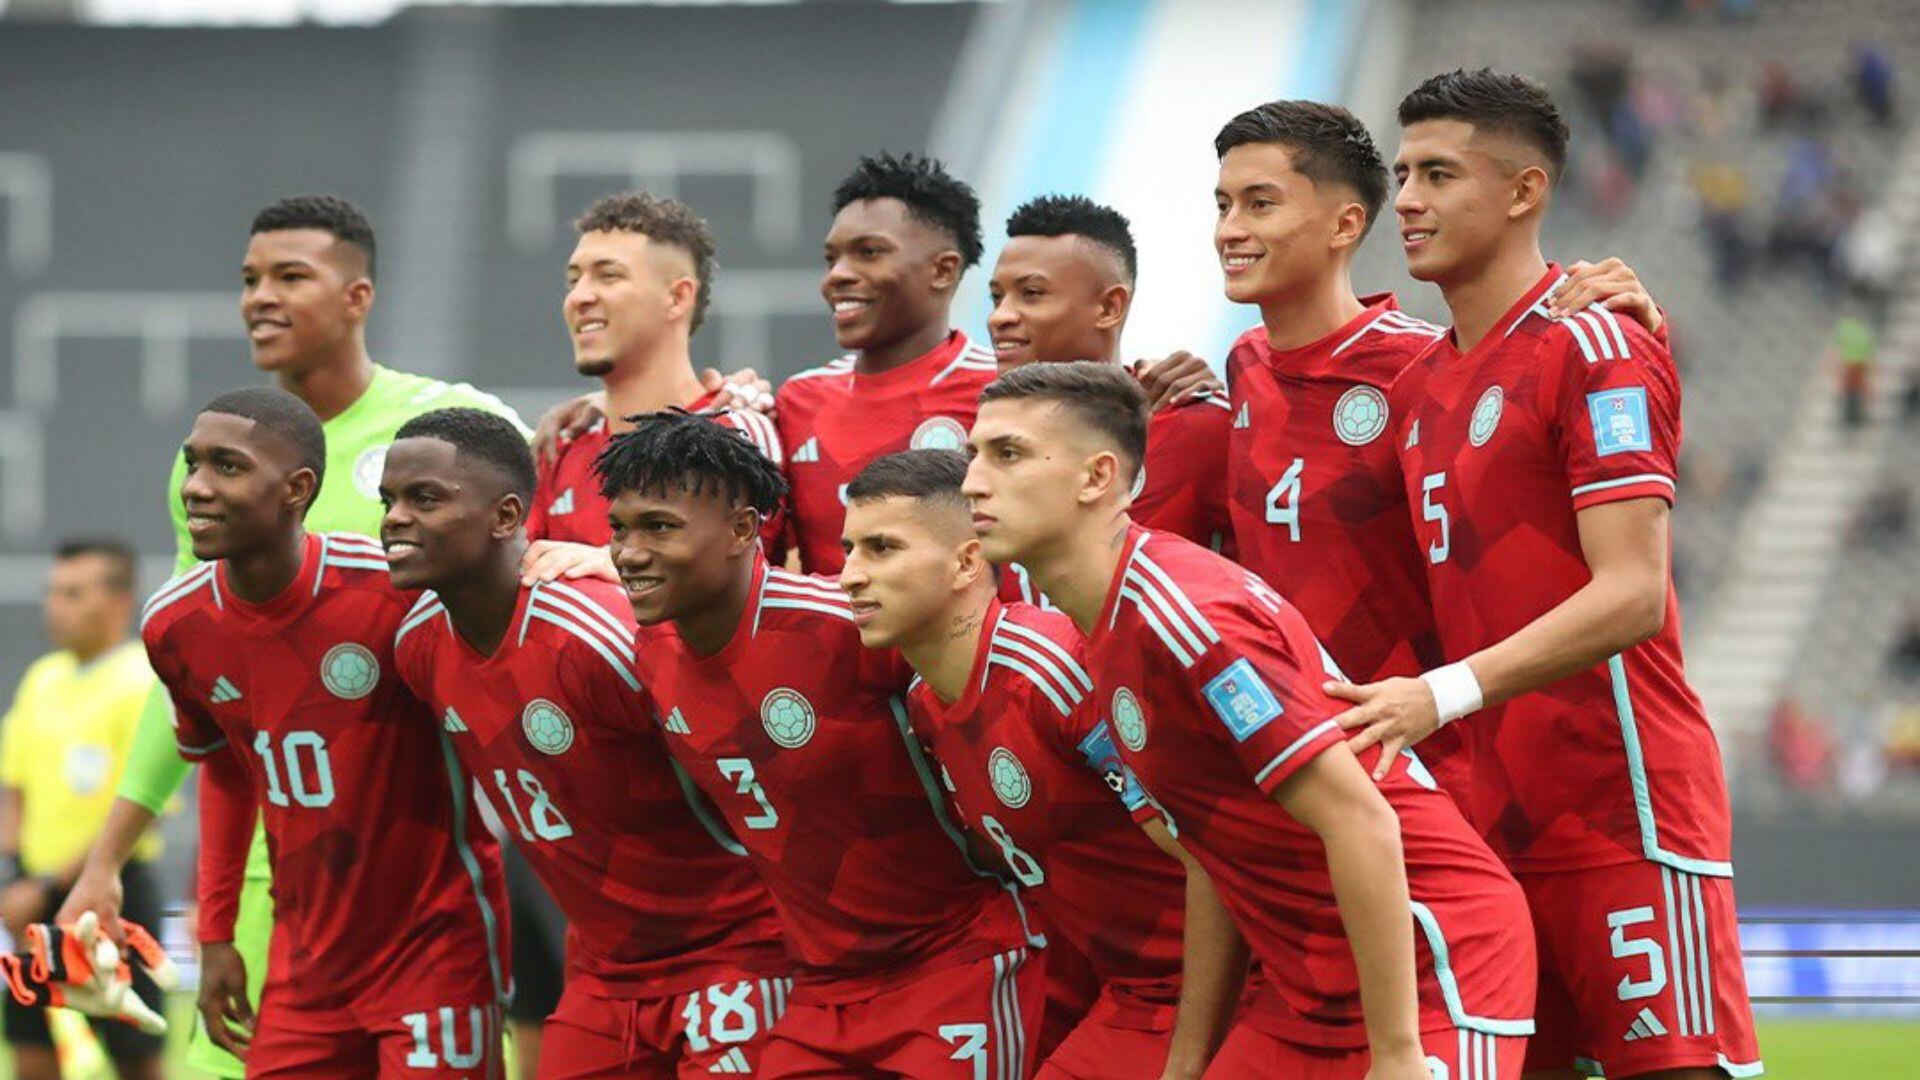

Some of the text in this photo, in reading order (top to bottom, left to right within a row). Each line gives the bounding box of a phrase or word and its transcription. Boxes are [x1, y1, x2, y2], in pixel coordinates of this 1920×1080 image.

[1264, 456, 1305, 543] 4
[1421, 470, 1451, 565] 5
[252, 729, 336, 809] 10
[493, 768, 574, 843] 18
[716, 757, 780, 830] 3
[982, 814, 1045, 888] 8
[1605, 904, 1669, 1002] 5
[680, 978, 759, 1053] 18
